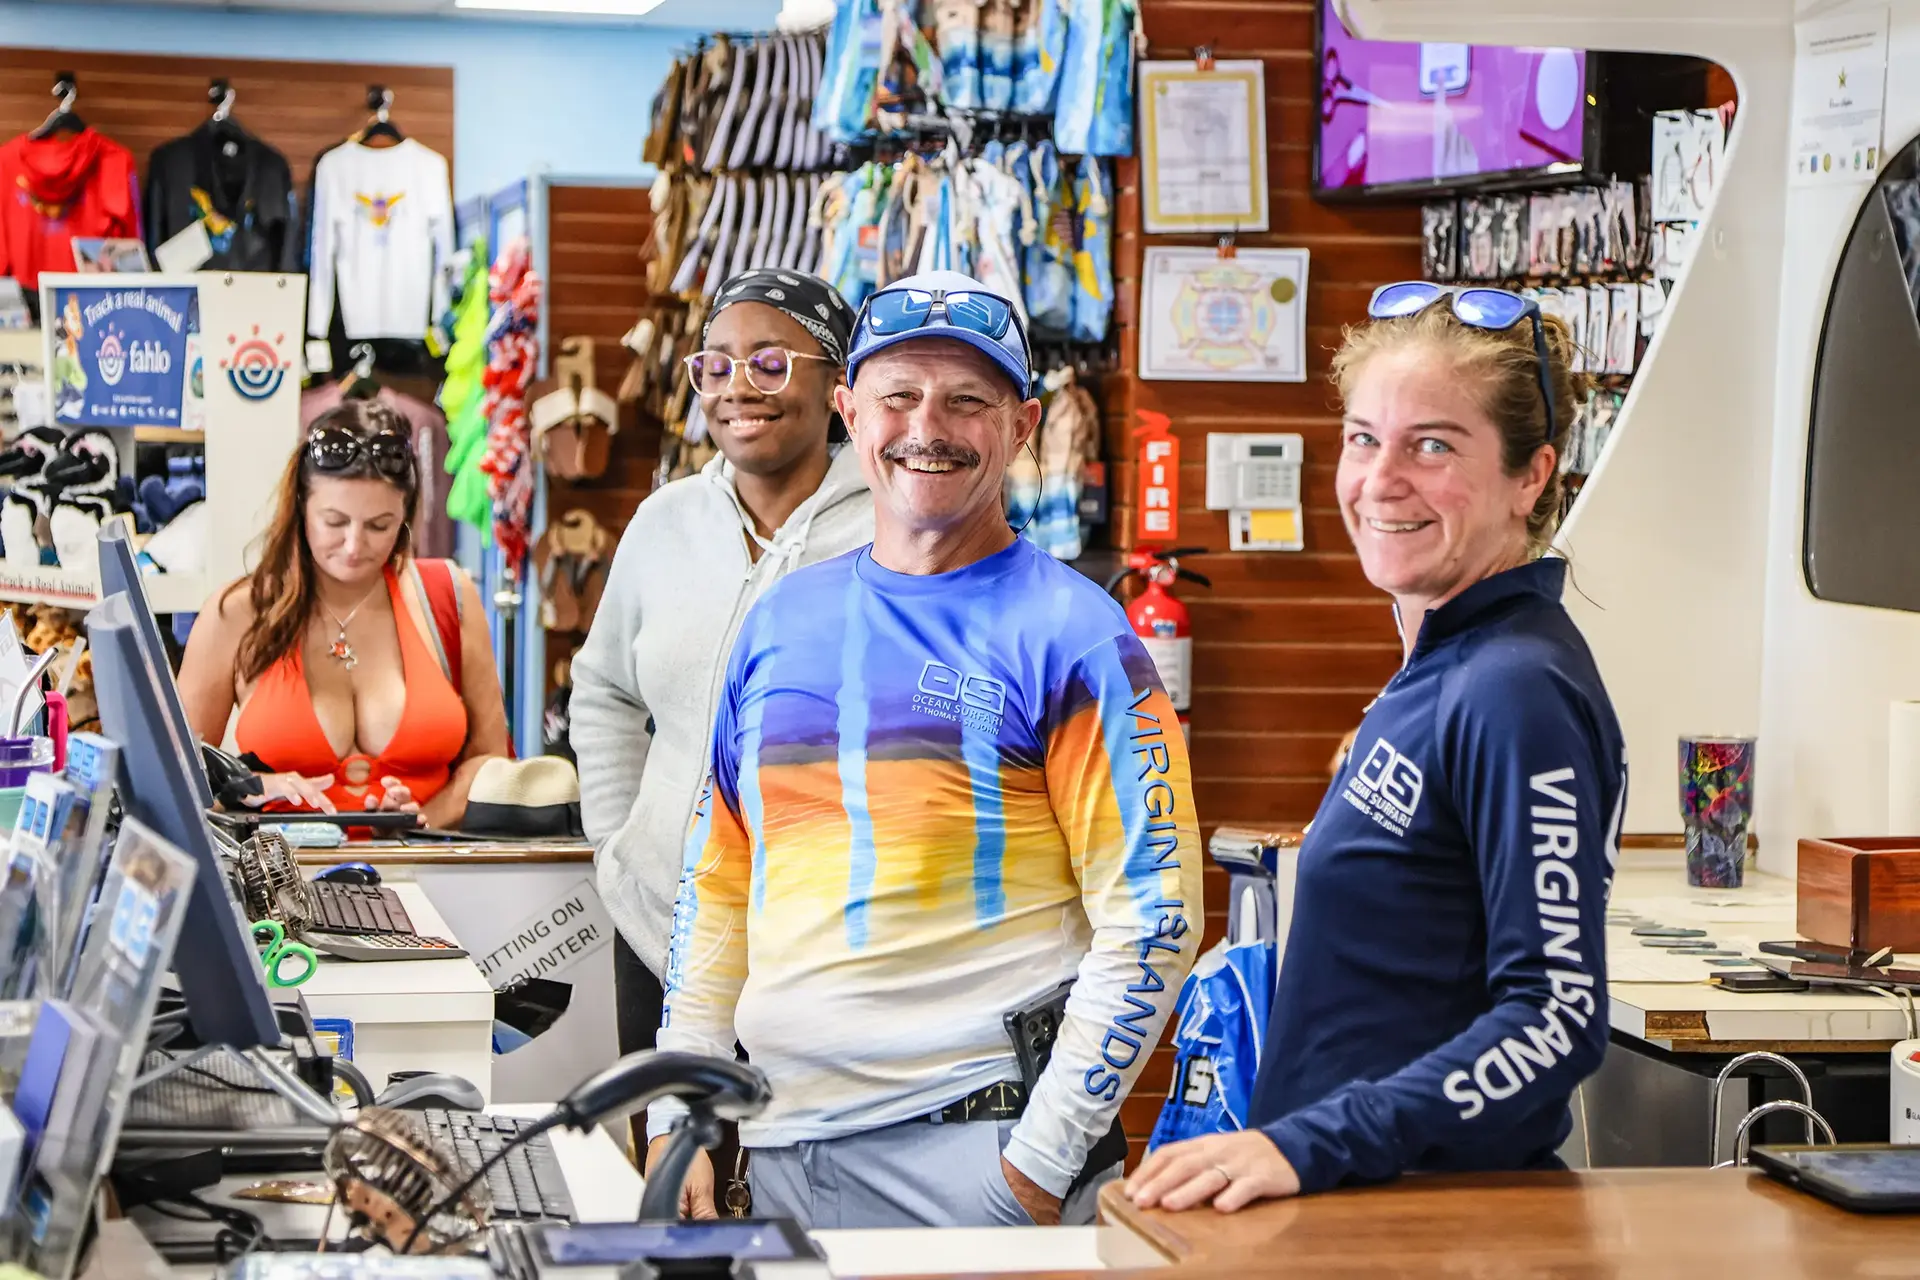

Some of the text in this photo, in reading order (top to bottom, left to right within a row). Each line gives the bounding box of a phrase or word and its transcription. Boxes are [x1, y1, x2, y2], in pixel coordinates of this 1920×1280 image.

[84, 287, 184, 334] Track a real animal
[129, 340, 171, 374] fahlo
[1145, 440, 1172, 532] FIRE
[34, 575, 56, 595] Real
[60, 580, 94, 598] Animal
[911, 704, 922, 713] ST.
[923, 706, 957, 722] THOMAS
[912, 694, 1004, 727] OCEAN SURFARI
[1124, 687, 1181, 872] VIRGIN
[1368, 792, 1412, 828] SURFARI
[1529, 767, 1583, 963] VIRGIN
[551, 897, 585, 926] ON
[1083, 899, 1189, 1102] ISLANDS
[1442, 968, 1596, 1121] ISLANDS
